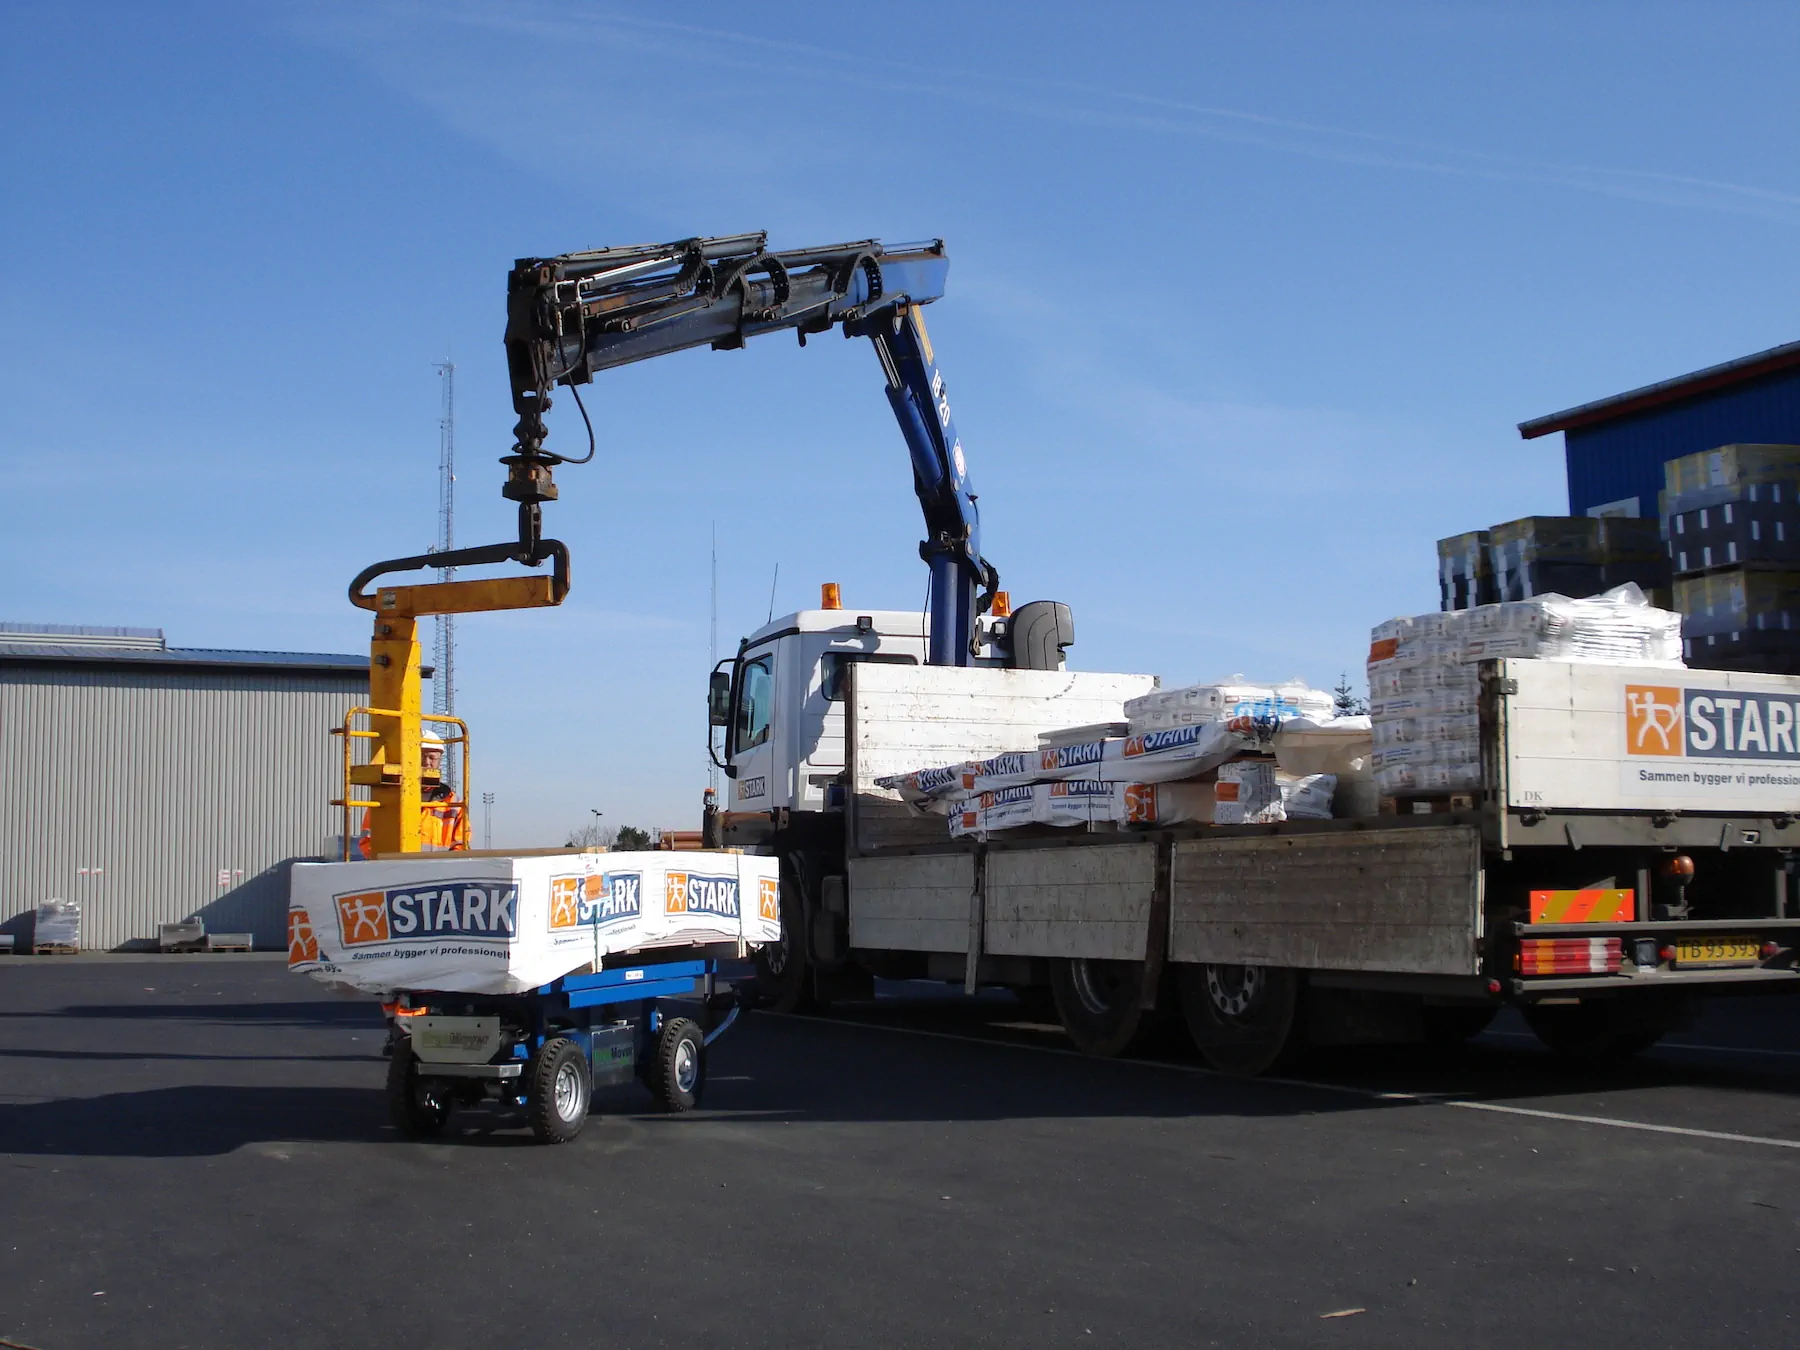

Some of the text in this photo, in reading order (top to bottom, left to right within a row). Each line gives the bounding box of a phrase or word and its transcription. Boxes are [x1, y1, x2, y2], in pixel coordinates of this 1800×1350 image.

[1639, 770, 1800, 787] Sammen bygger vi professio
[1524, 791, 1543, 801] DK
[688, 879, 738, 915] STARK
[391, 889, 516, 934] STARK
[352, 946, 511, 961] Sammen bygger vi professionelt
